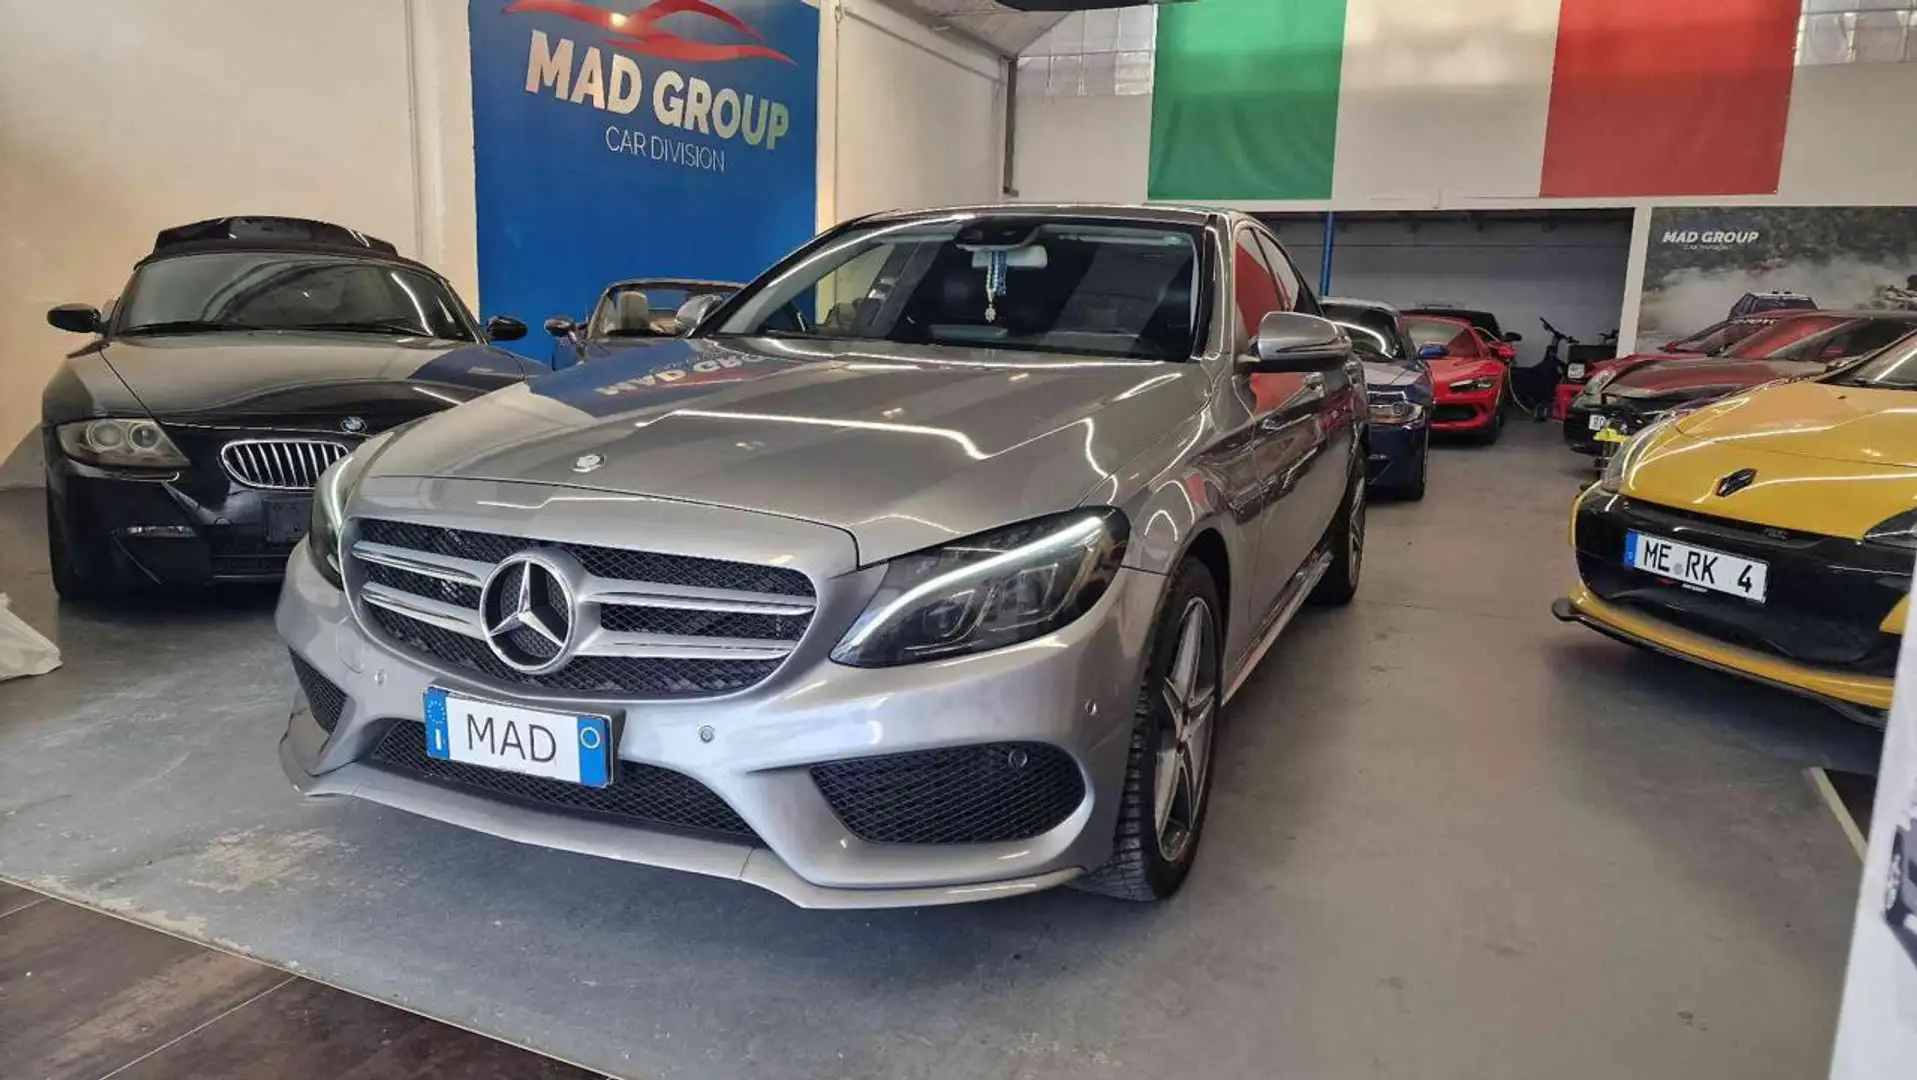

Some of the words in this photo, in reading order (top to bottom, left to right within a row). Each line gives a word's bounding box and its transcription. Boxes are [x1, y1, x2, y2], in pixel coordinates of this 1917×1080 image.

[526, 29, 642, 115] MAD
[652, 70, 789, 149] GROUP
[605, 125, 646, 157] CAR
[651, 135, 725, 173] DIVISION
[1662, 230, 1699, 243] MAD
[1701, 230, 1759, 243] GROUP
[1643, 540, 1671, 572] ME
[1685, 551, 1718, 584] RK
[1737, 564, 1752, 593] 4
[466, 713, 557, 763] MAD
